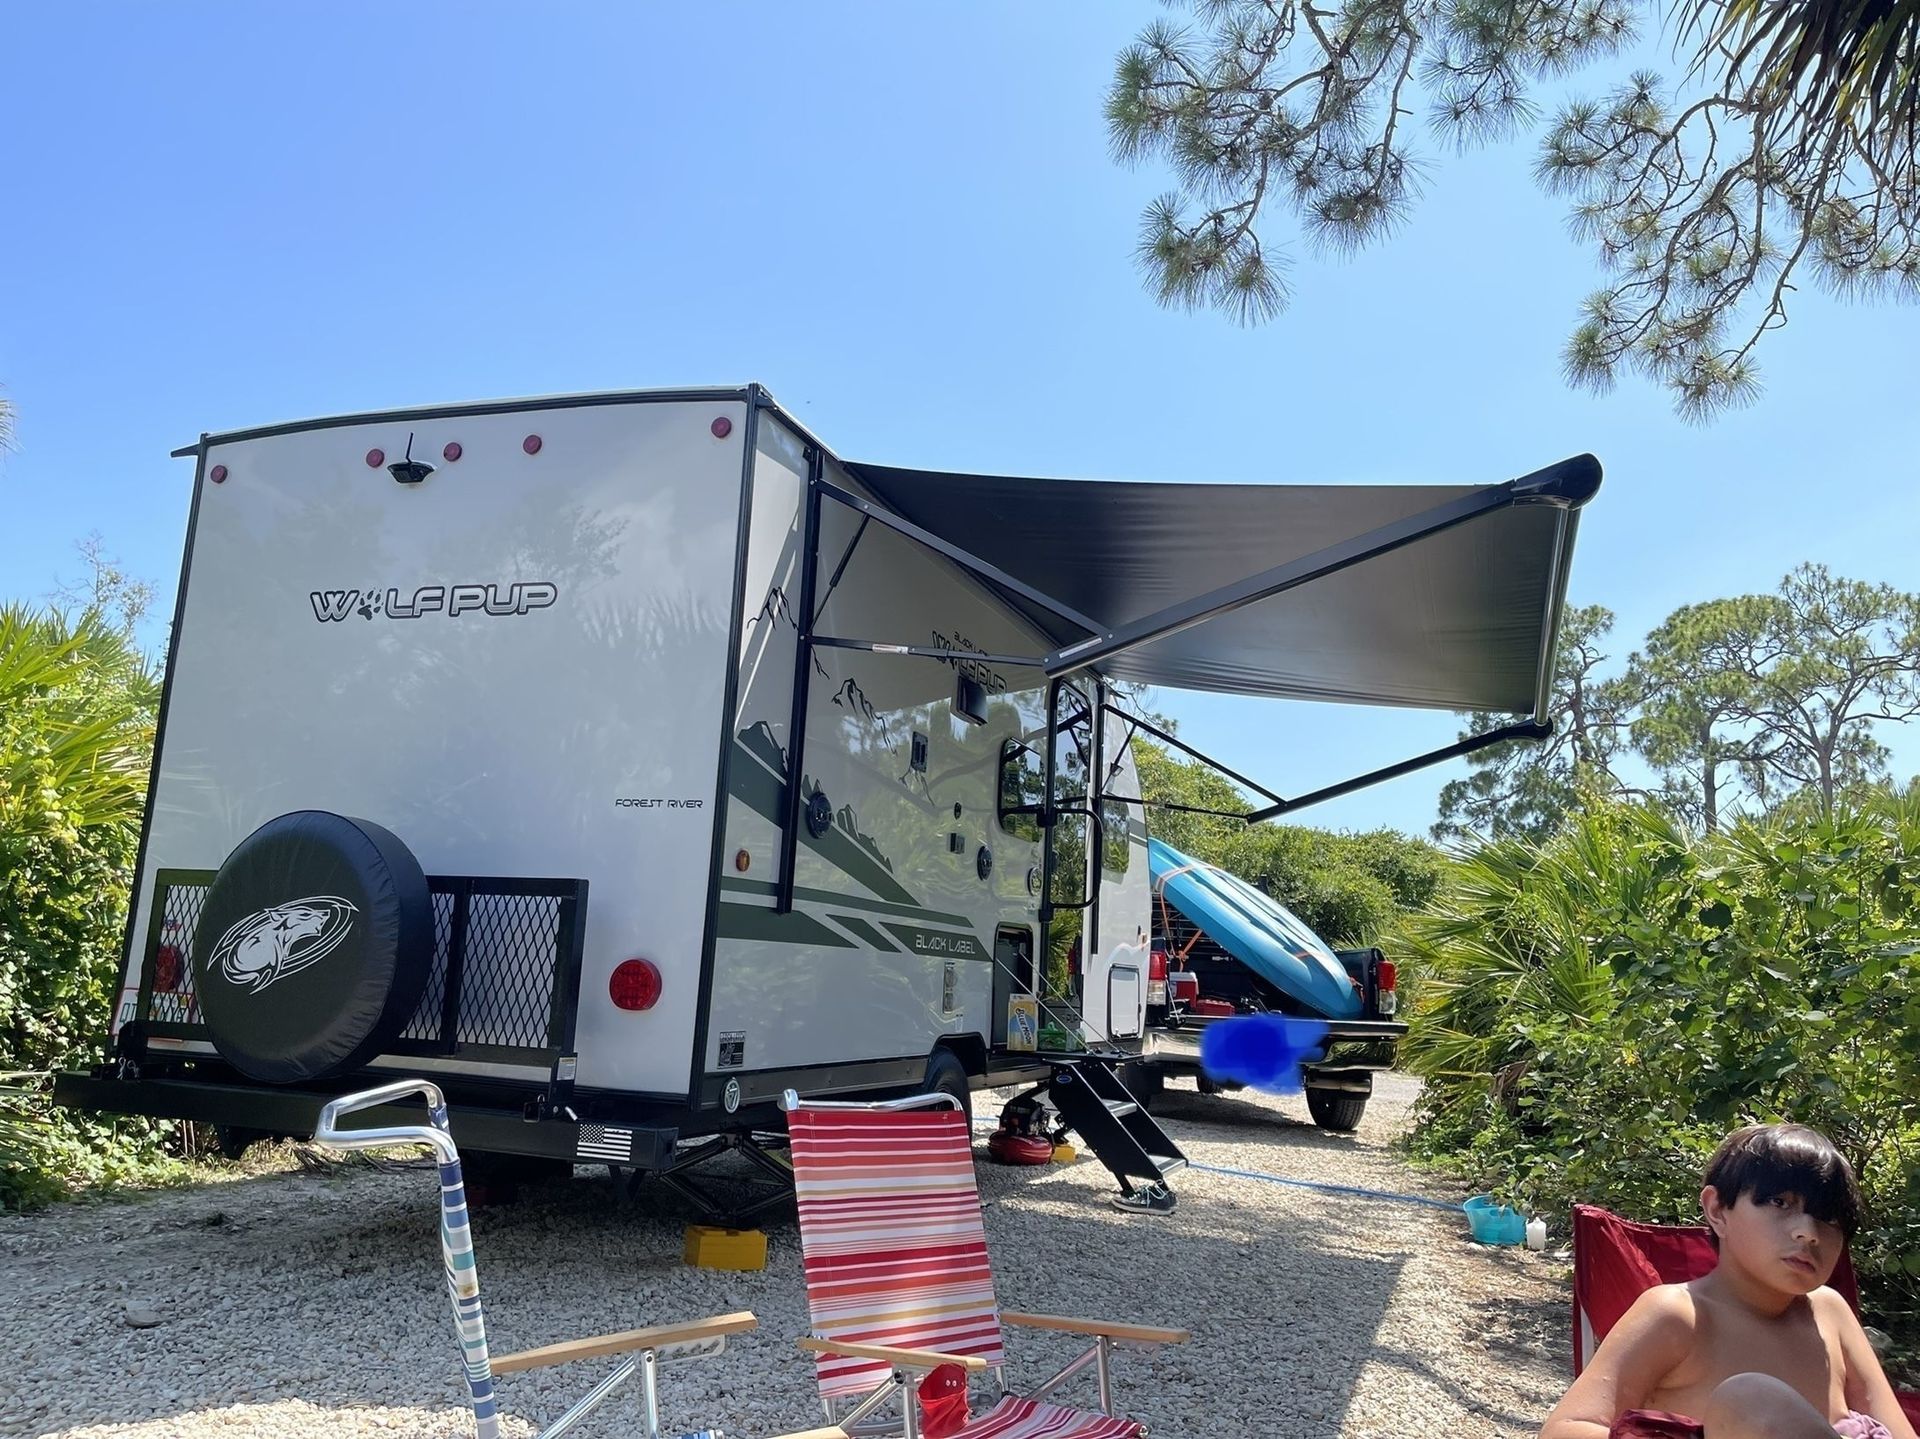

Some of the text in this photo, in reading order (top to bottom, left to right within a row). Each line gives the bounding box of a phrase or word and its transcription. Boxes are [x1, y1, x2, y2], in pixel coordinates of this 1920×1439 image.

[615, 799, 703, 809] FOREST RIVER
[915, 934, 976, 955] BLACK LABEL
[1015, 1007, 1027, 1026] BLUE
[1021, 1026, 1033, 1045] MOON
